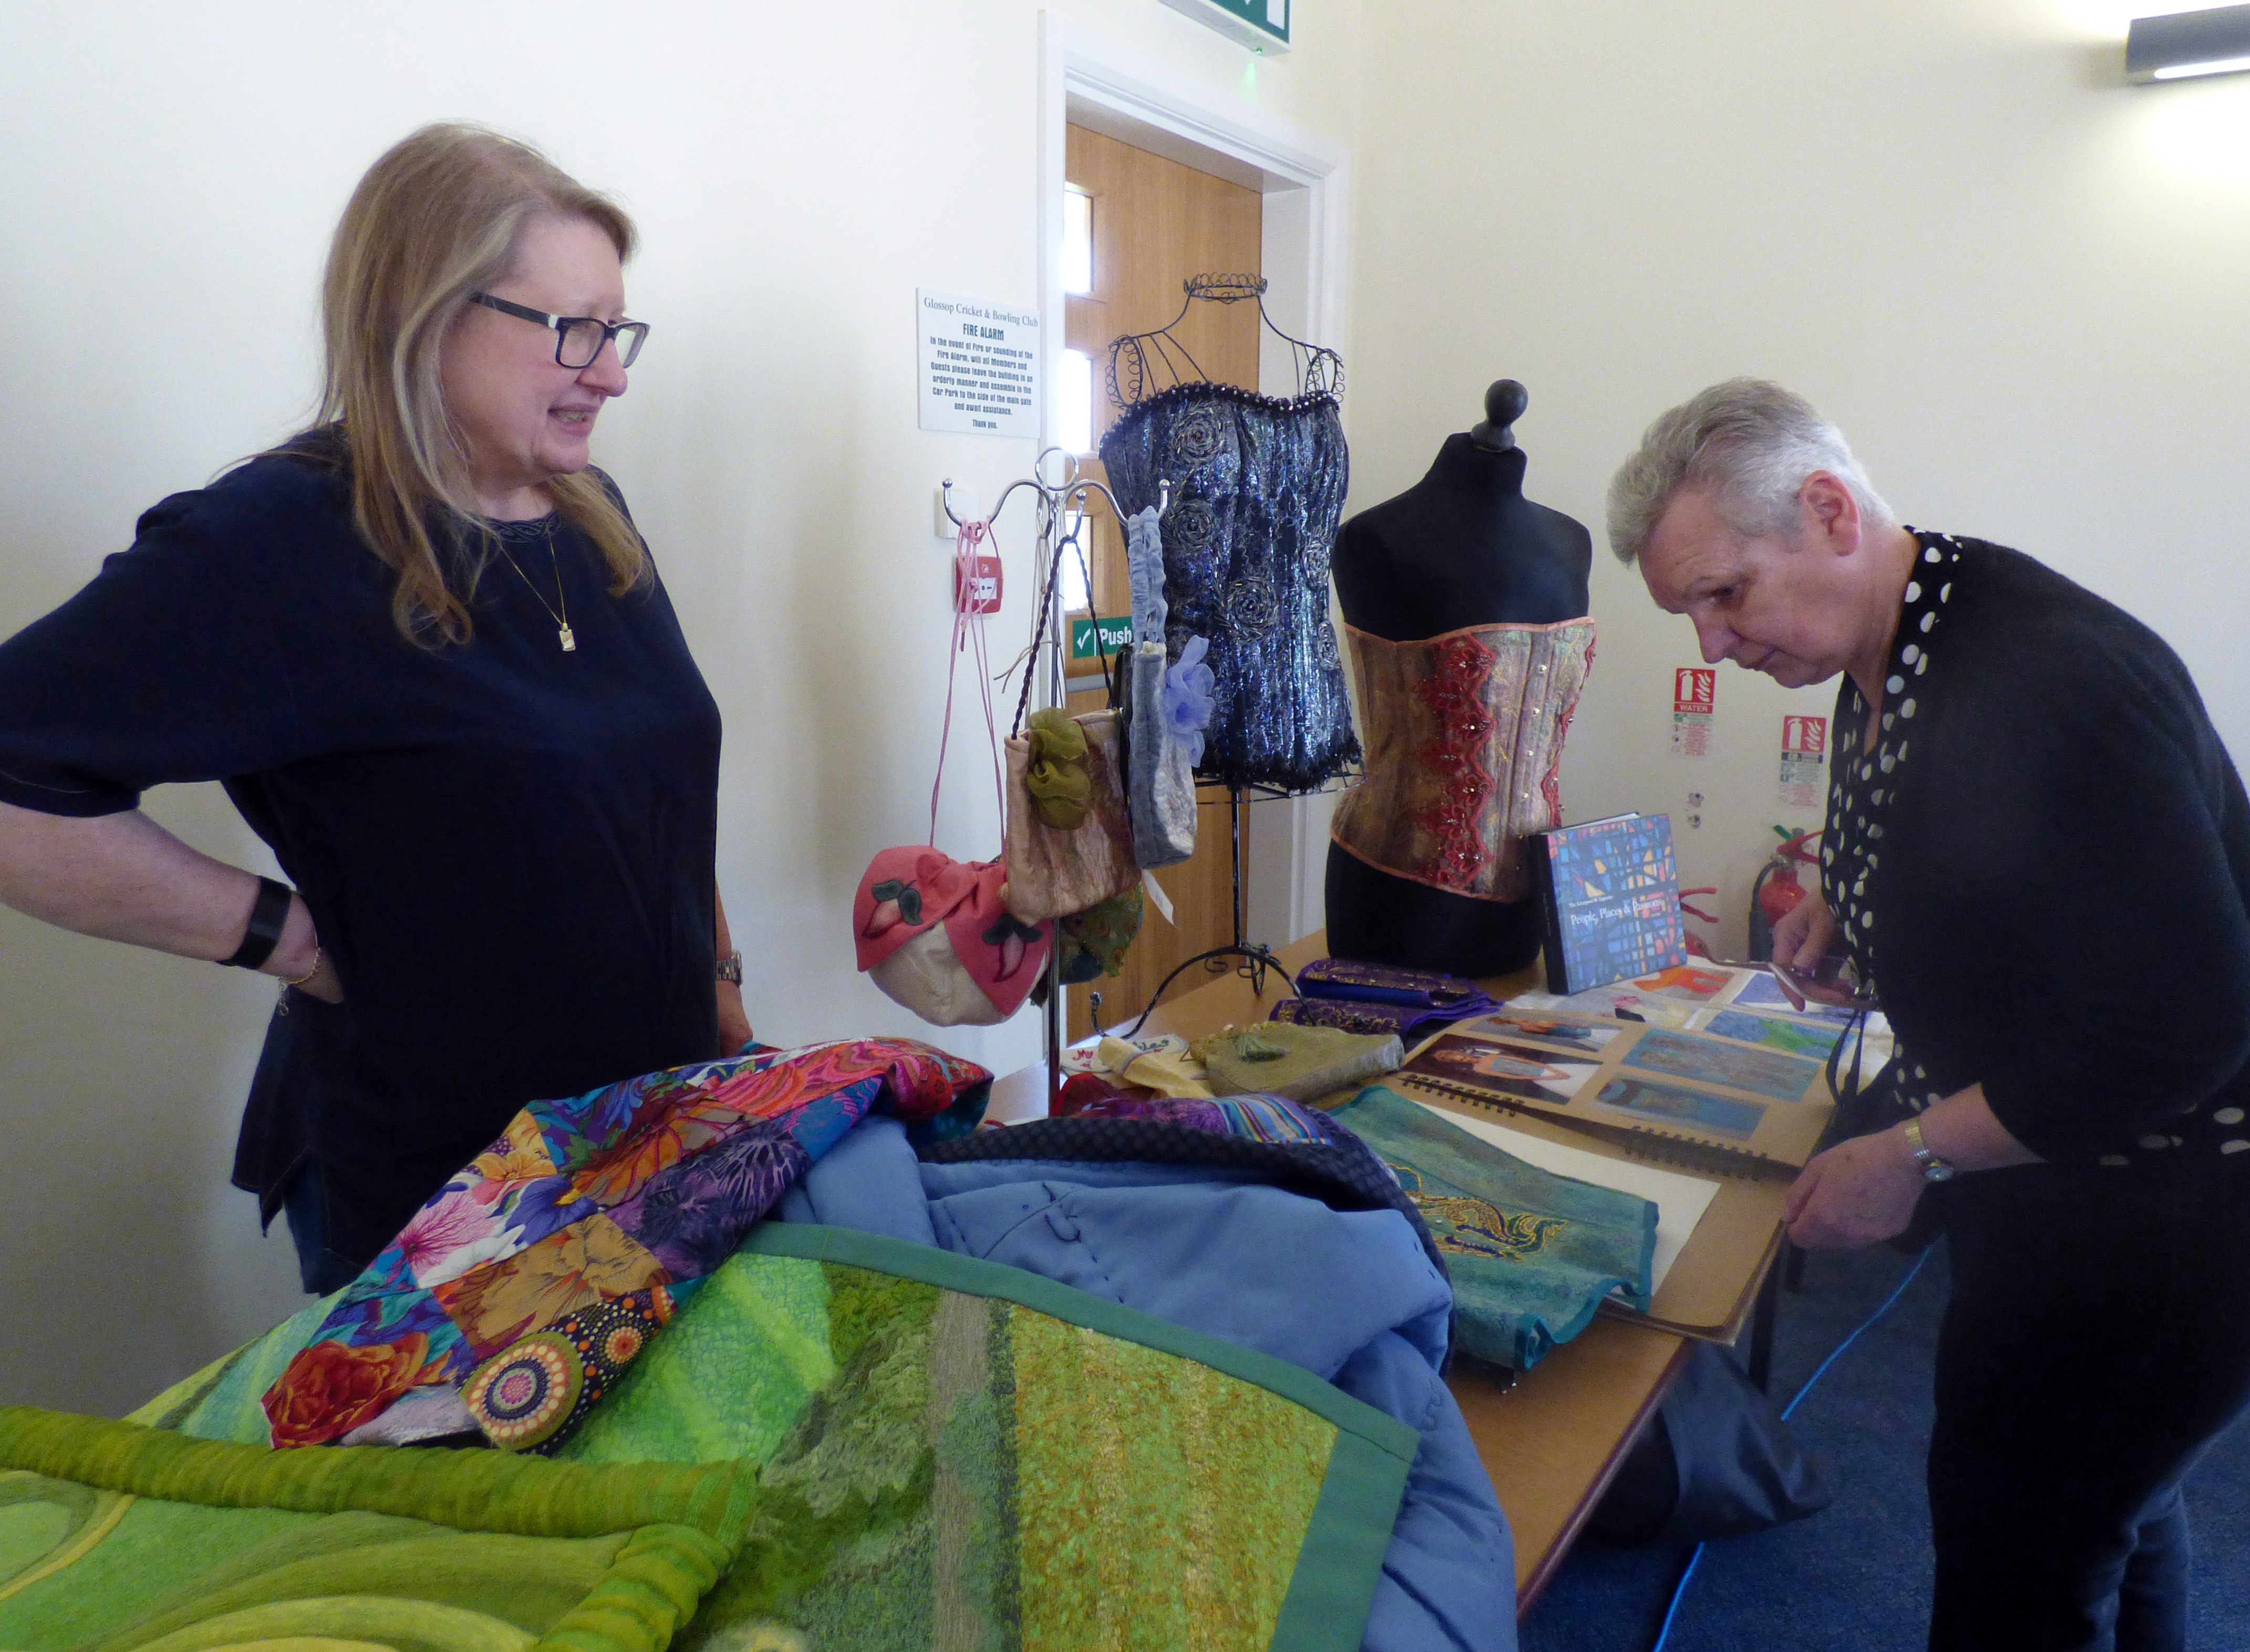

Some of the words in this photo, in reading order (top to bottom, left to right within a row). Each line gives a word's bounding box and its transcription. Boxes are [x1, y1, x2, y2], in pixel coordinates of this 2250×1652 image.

[924, 297, 954, 314] Glossop
[956, 304, 982, 317] Cricket
[984, 309, 990, 319] &
[993, 309, 1020, 326] Bowling
[1022, 315, 1038, 326] Club
[963, 324, 978, 337] FIRE
[980, 326, 1004, 341] ALARM
[930, 336, 936, 345] In
[938, 338, 947, 346] the
[948, 340, 964, 349] event
[973, 343, 983, 352] Fire
[993, 347, 1017, 358] sounding
[937, 350, 949, 359] Fire
[991, 358, 1016, 368] Members
[931, 361, 950, 371] Guests
[952, 365, 970, 375] please
[972, 367, 987, 376] leave
[998, 371, 1019, 381] building
[933, 375, 955, 385] orderly
[957, 378, 978, 387] manner
[991, 382, 1015, 392] assemble
[933, 387, 943, 396] Car
[945, 388, 958, 398] Park
[967, 391, 976, 399] the
[977, 392, 988, 401] side
[983, 406, 1012, 415] assistance.
[972, 419, 987, 428] Thank
[1099, 626, 1132, 646] Push
[1600, 907, 1620, 919] Places
[1624, 905, 1631, 913] &
